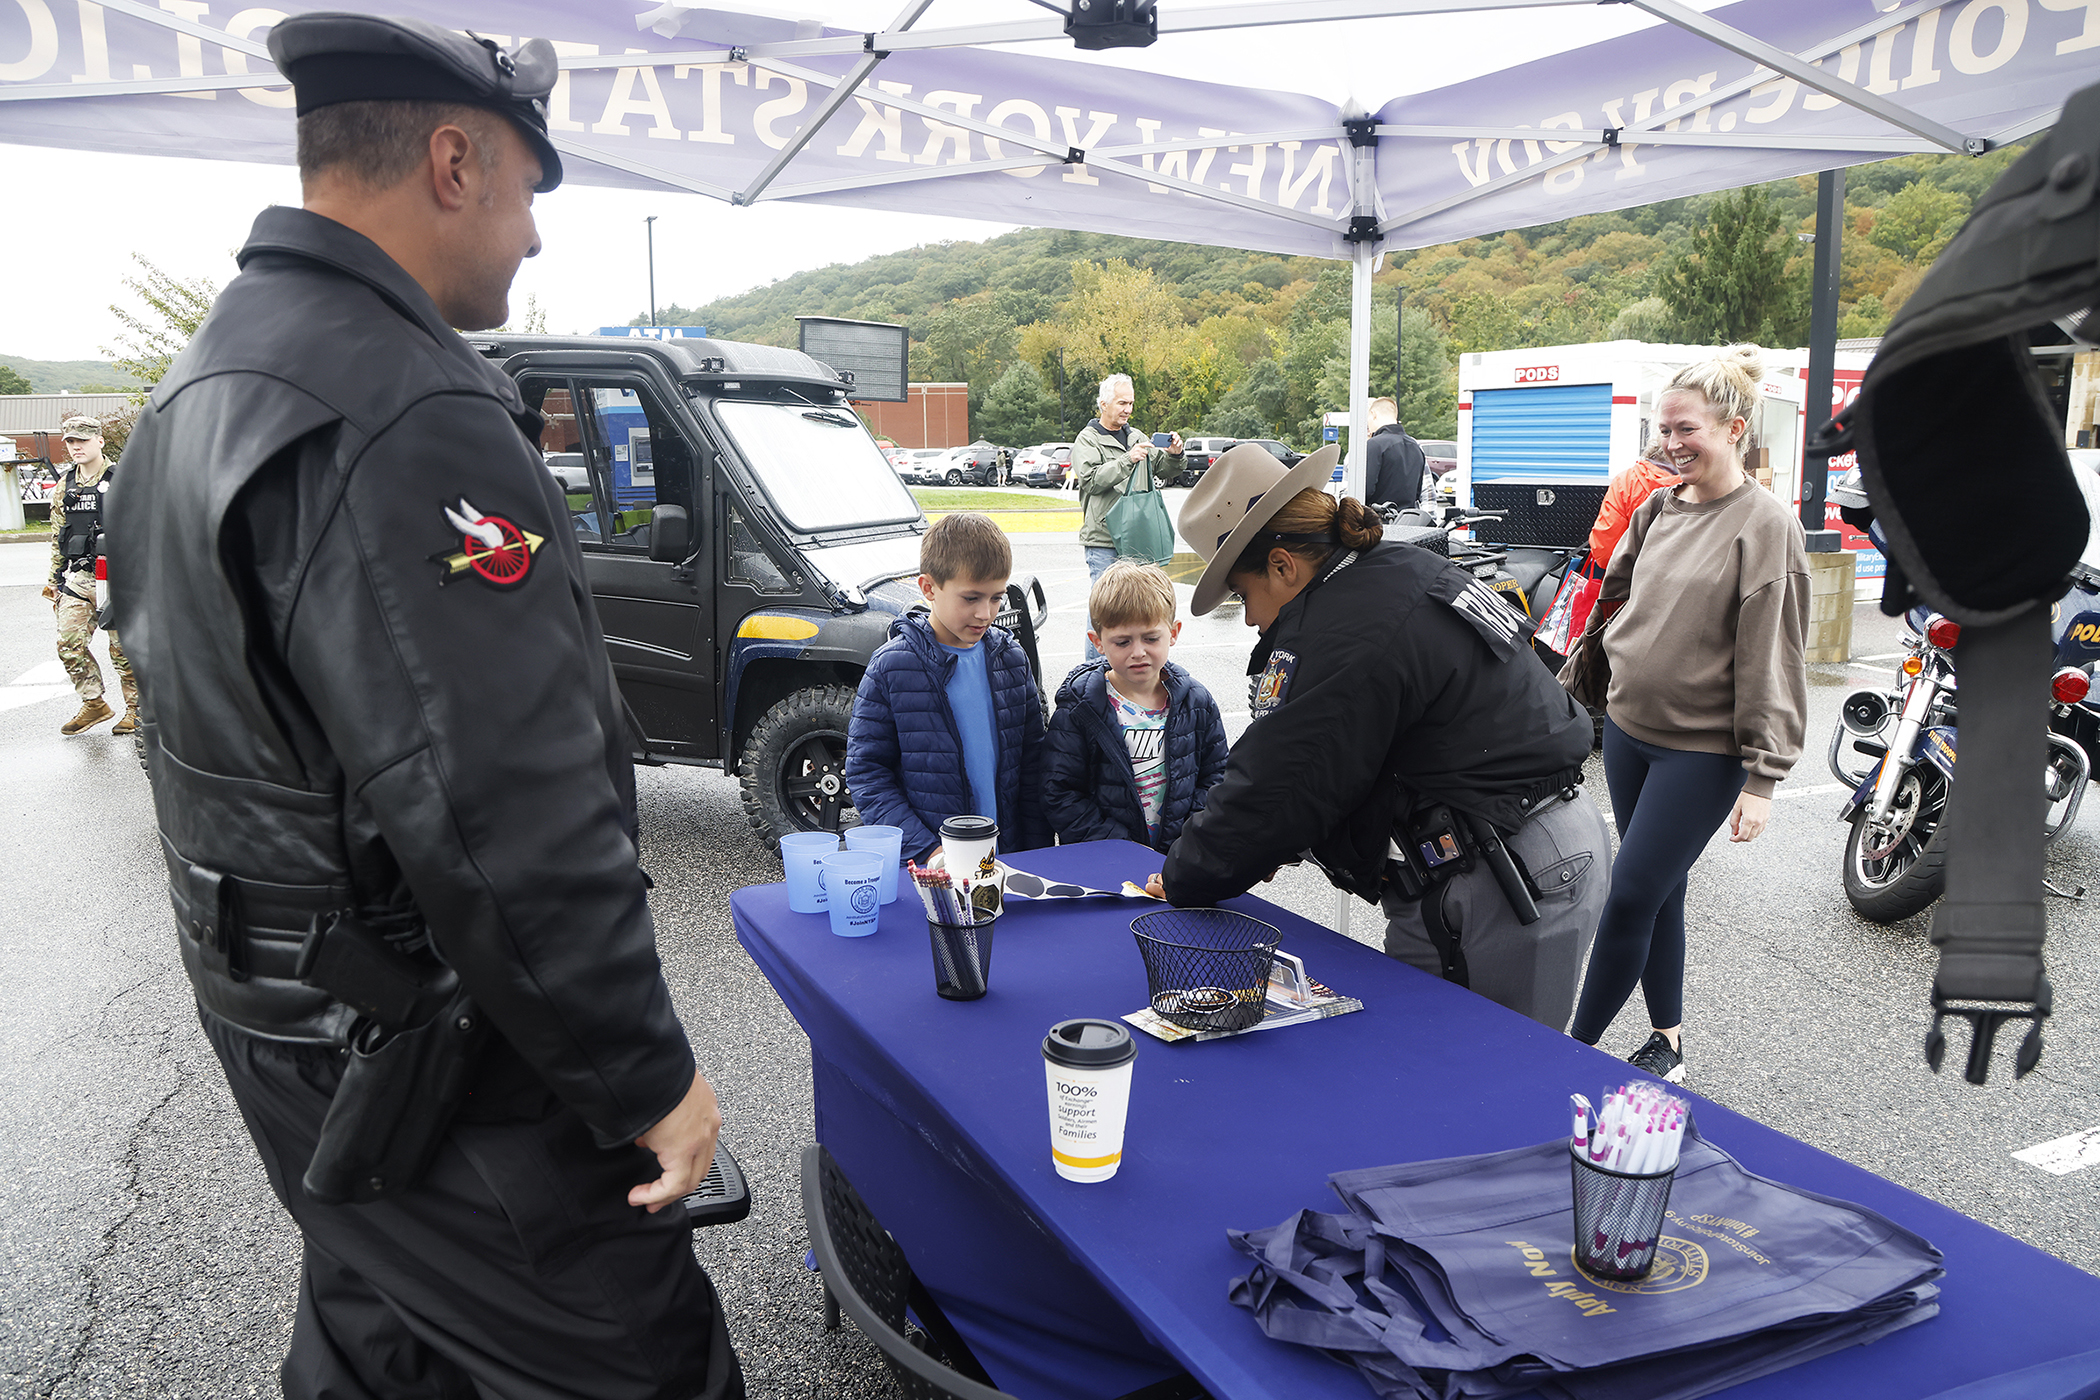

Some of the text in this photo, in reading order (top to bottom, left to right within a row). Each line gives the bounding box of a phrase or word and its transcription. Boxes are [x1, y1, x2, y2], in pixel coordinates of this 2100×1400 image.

[628, 328, 683, 340] ATM
[1515, 366, 1558, 381] PODS
[1489, 579, 1519, 592] OOPER
[1275, 650, 1296, 664] YORK
[1124, 729, 1165, 758] NIK
[1056, 1082, 1097, 1097] 100%
[1058, 1105, 1096, 1117] support
[1058, 1125, 1097, 1139] Families
[1690, 1214, 1759, 1239] #JoinNYSP
[1664, 1210, 1770, 1265] JoinStatePolice.ny.g
[1685, 1245, 1703, 1278] STATE
[1505, 1240, 1617, 1317] Apply Now
